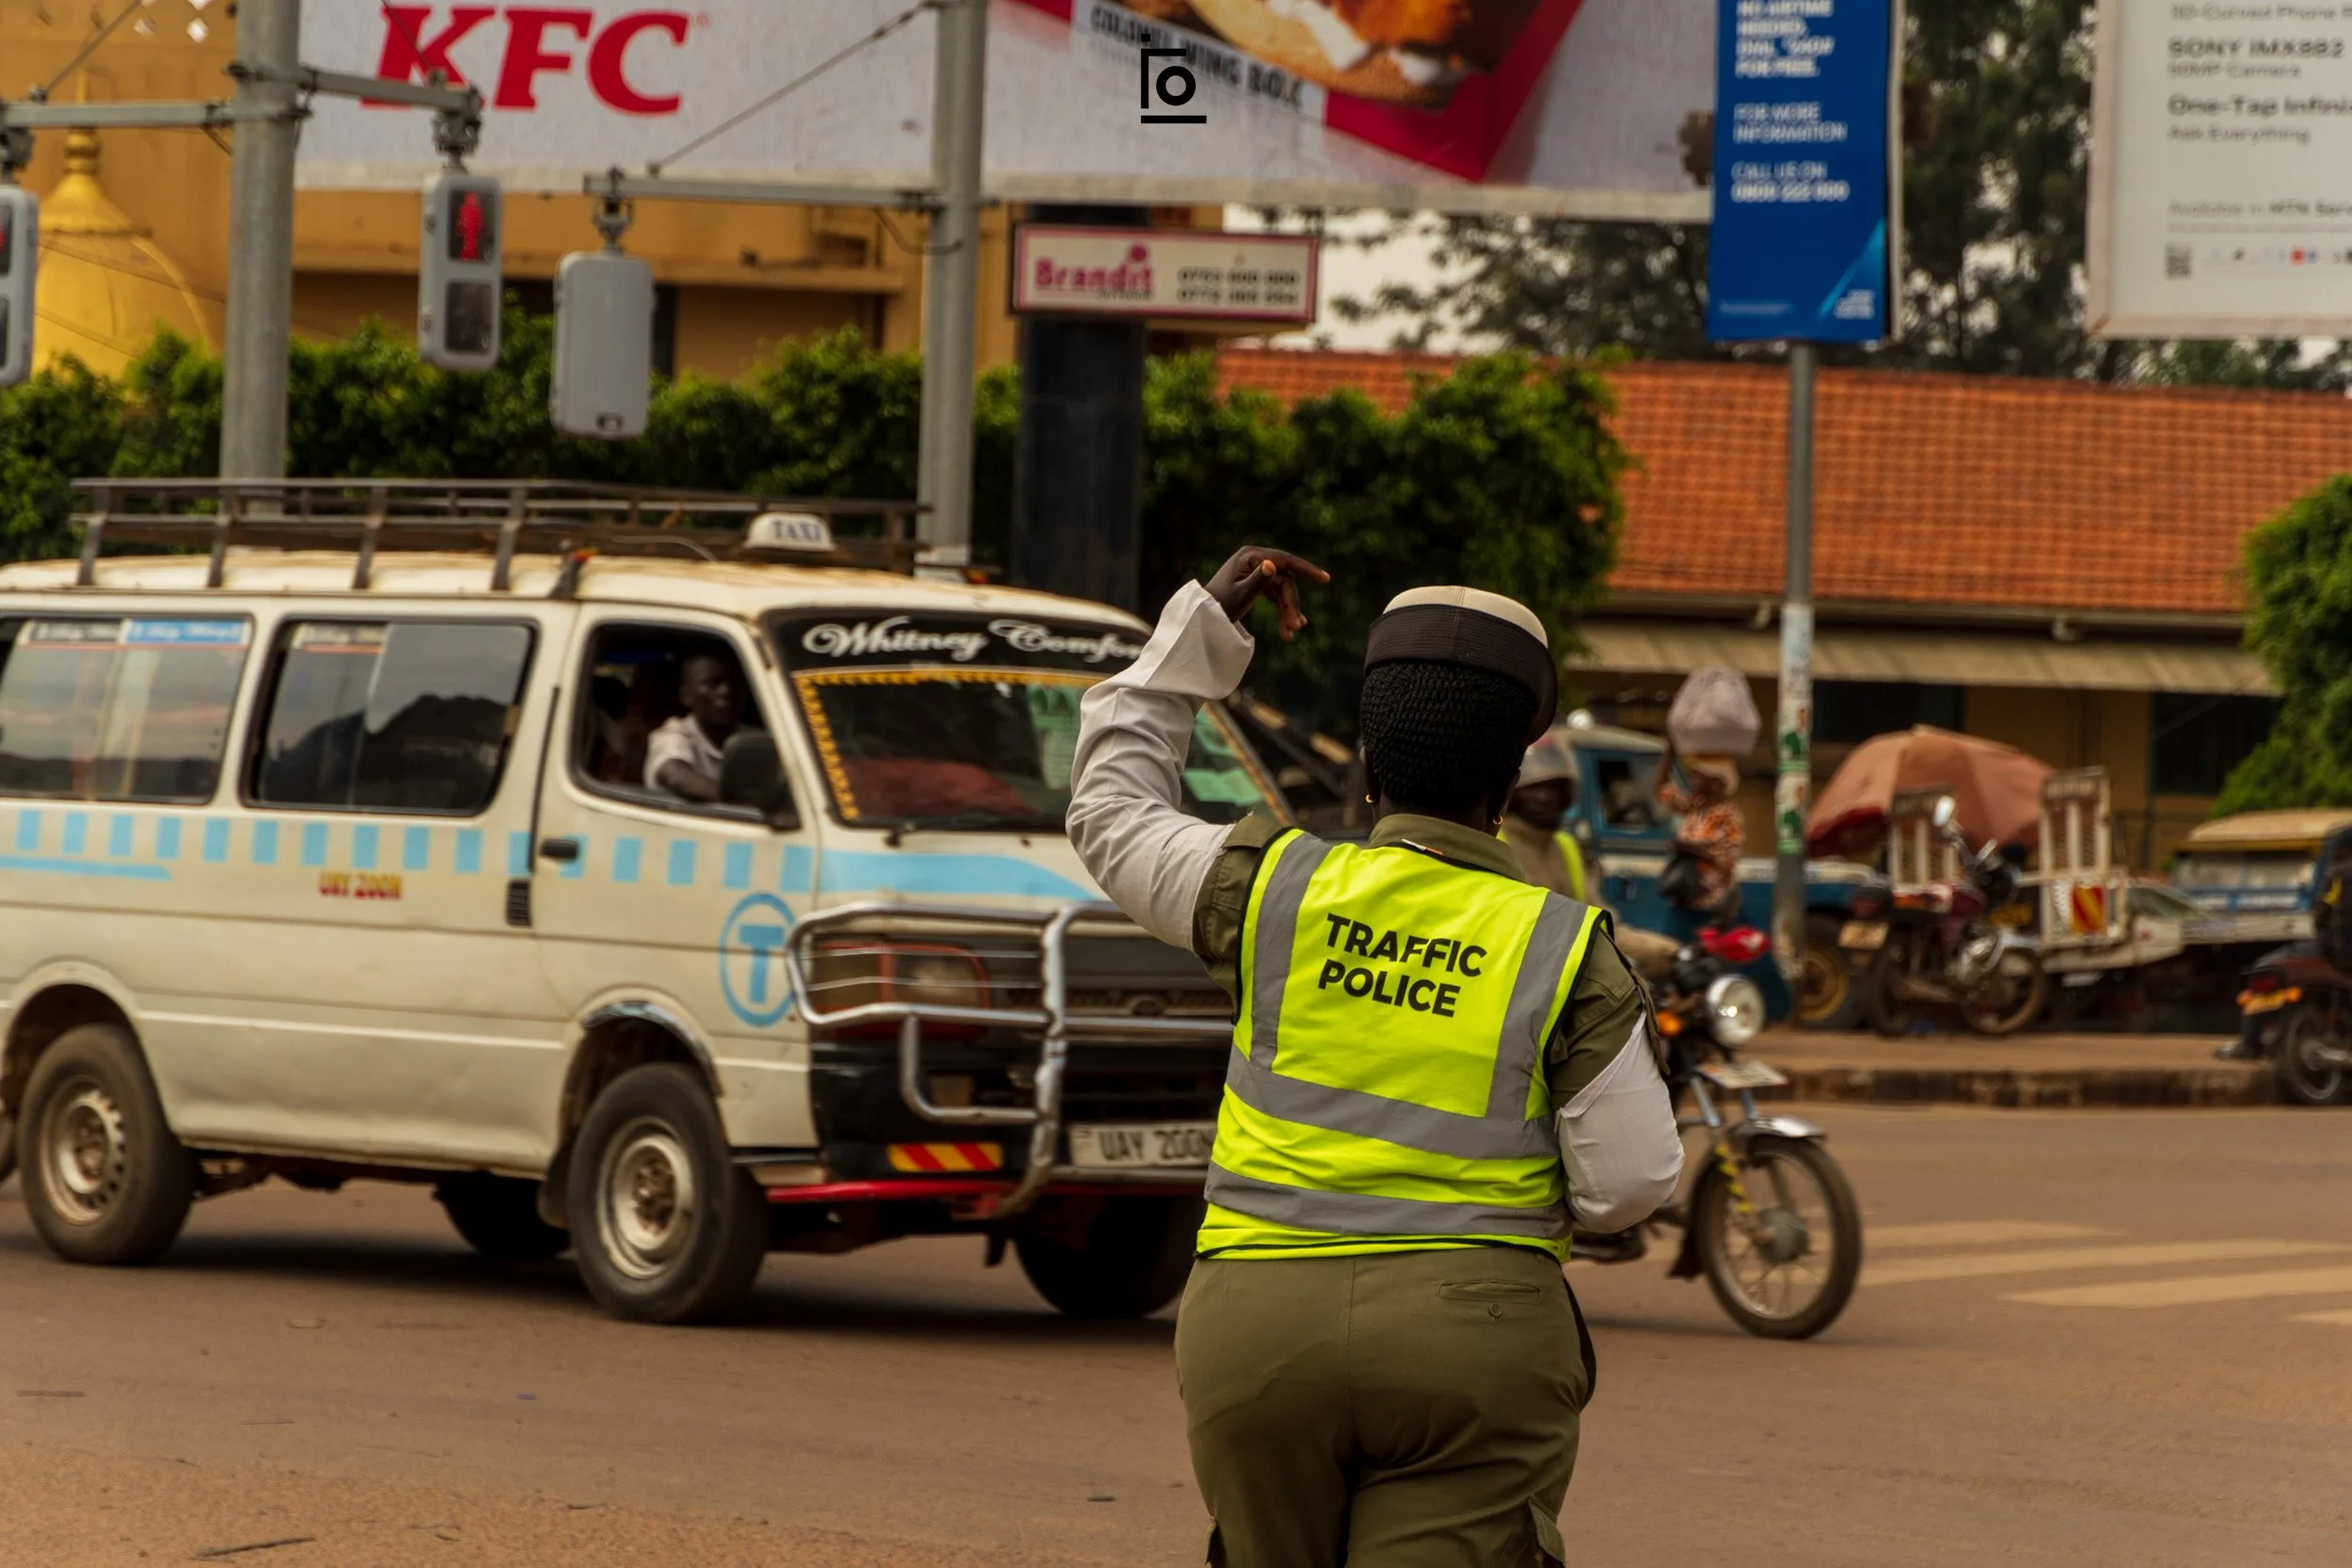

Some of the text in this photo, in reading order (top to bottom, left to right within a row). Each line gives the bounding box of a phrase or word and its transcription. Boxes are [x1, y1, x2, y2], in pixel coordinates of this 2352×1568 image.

[2168, 35, 2243, 59] SONY
[359, 6, 690, 117] KFC
[2225, 60, 2302, 79] Camera
[1733, 101, 1822, 121] FOR MORE
[2167, 92, 2279, 119] One-Tap
[1733, 120, 1849, 144] INFORMATION
[2207, 123, 2313, 147] Everything
[1731, 160, 1772, 181] CALL
[1034, 242, 1154, 292] Brandit
[771, 518, 822, 541] TAXI
[802, 615, 1142, 663] Whitney Comfor
[1327, 912, 1487, 977] TRAFFIC
[739, 924, 784, 1004] T
[1318, 958, 1461, 1018] POLICE
[1098, 1130, 1144, 1161] UAY
